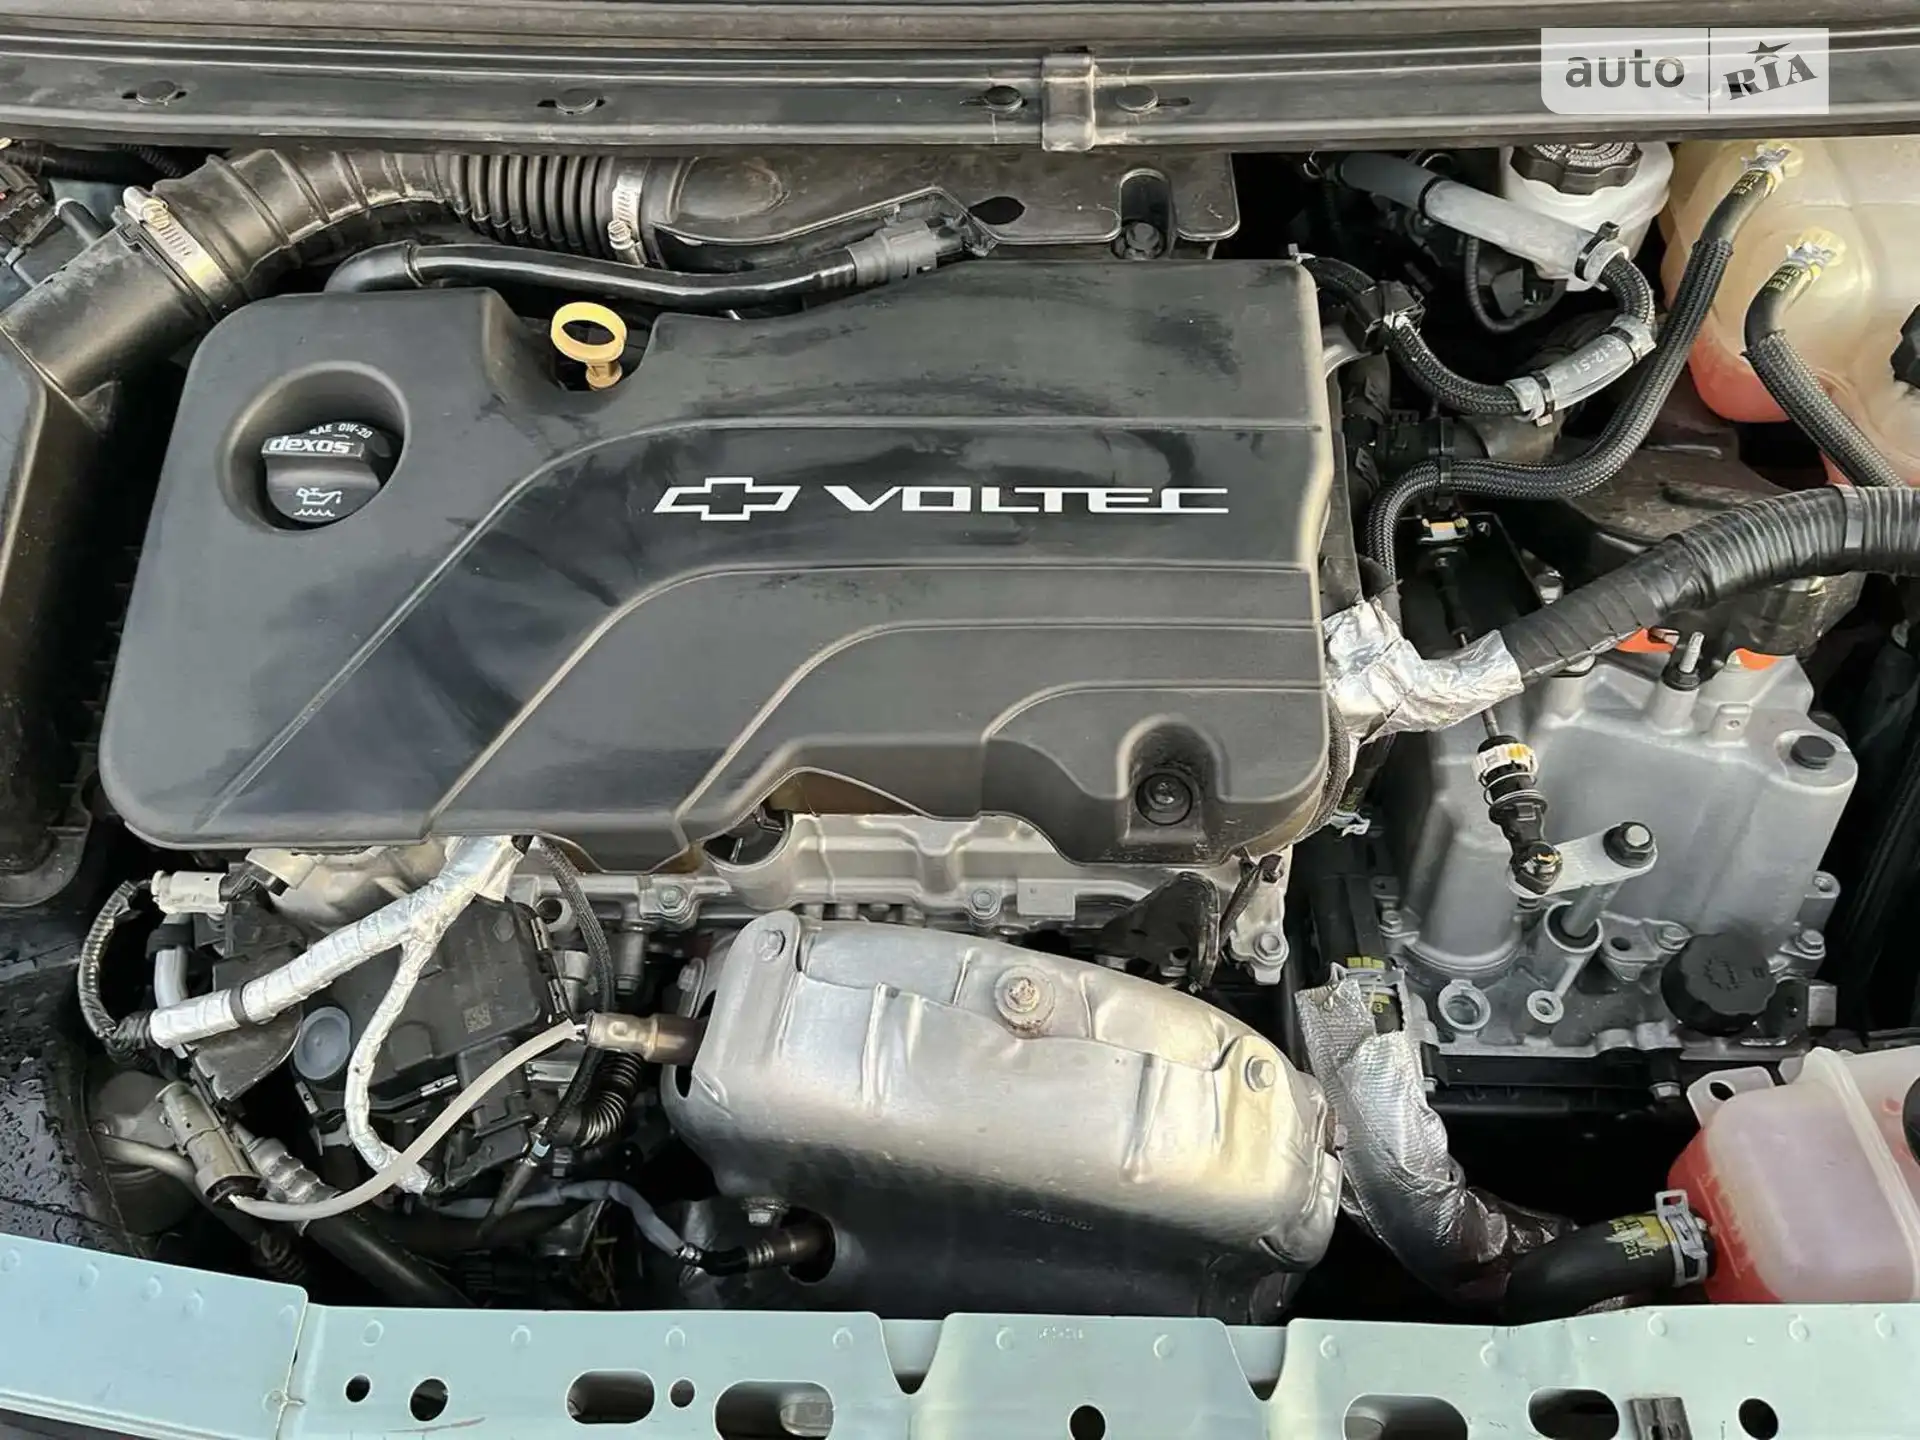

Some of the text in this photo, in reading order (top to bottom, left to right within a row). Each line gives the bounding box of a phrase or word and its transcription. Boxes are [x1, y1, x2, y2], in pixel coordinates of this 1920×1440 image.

[338, 422, 374, 439] 0W-20
[268, 435, 355, 454] dexos
[824, 486, 1229, 513] VOLTEC
